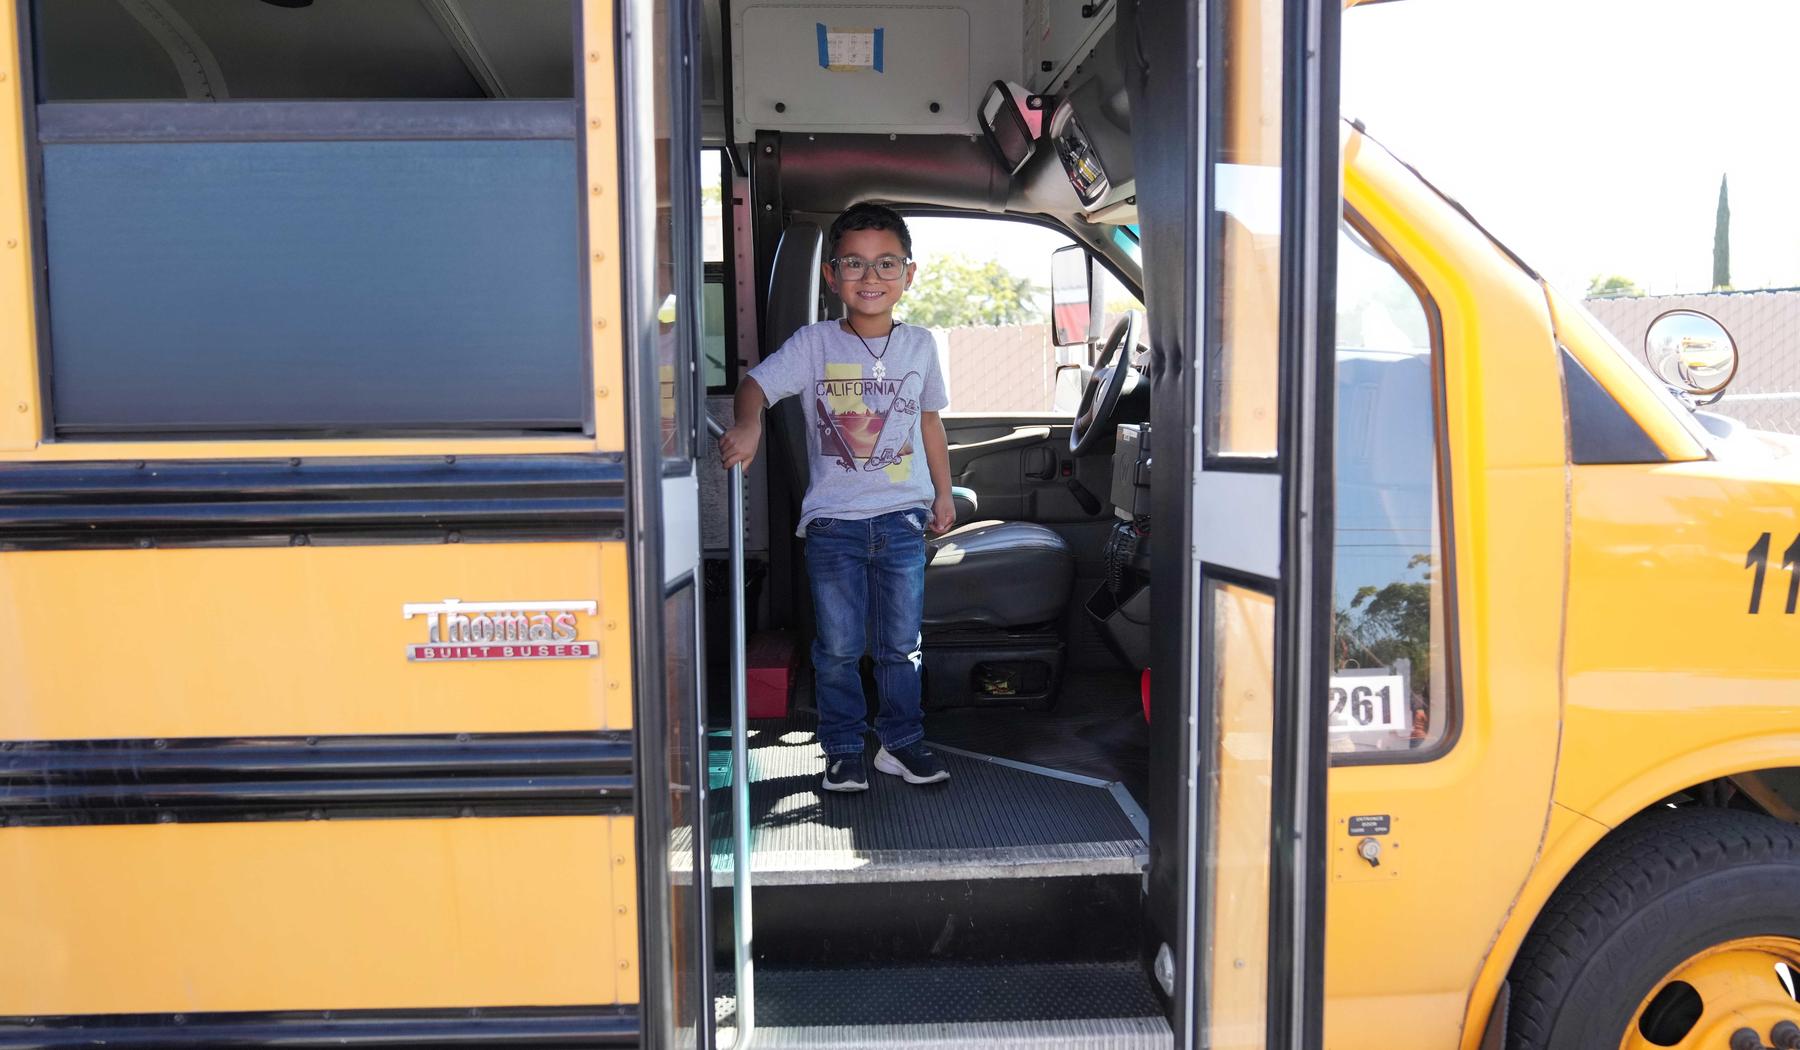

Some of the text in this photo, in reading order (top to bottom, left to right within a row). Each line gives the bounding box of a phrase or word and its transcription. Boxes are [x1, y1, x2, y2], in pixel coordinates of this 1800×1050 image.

[815, 381, 896, 397] CALIFORNIA
[404, 599, 597, 643] Thomas
[423, 645, 583, 659] BUILT BUSES
